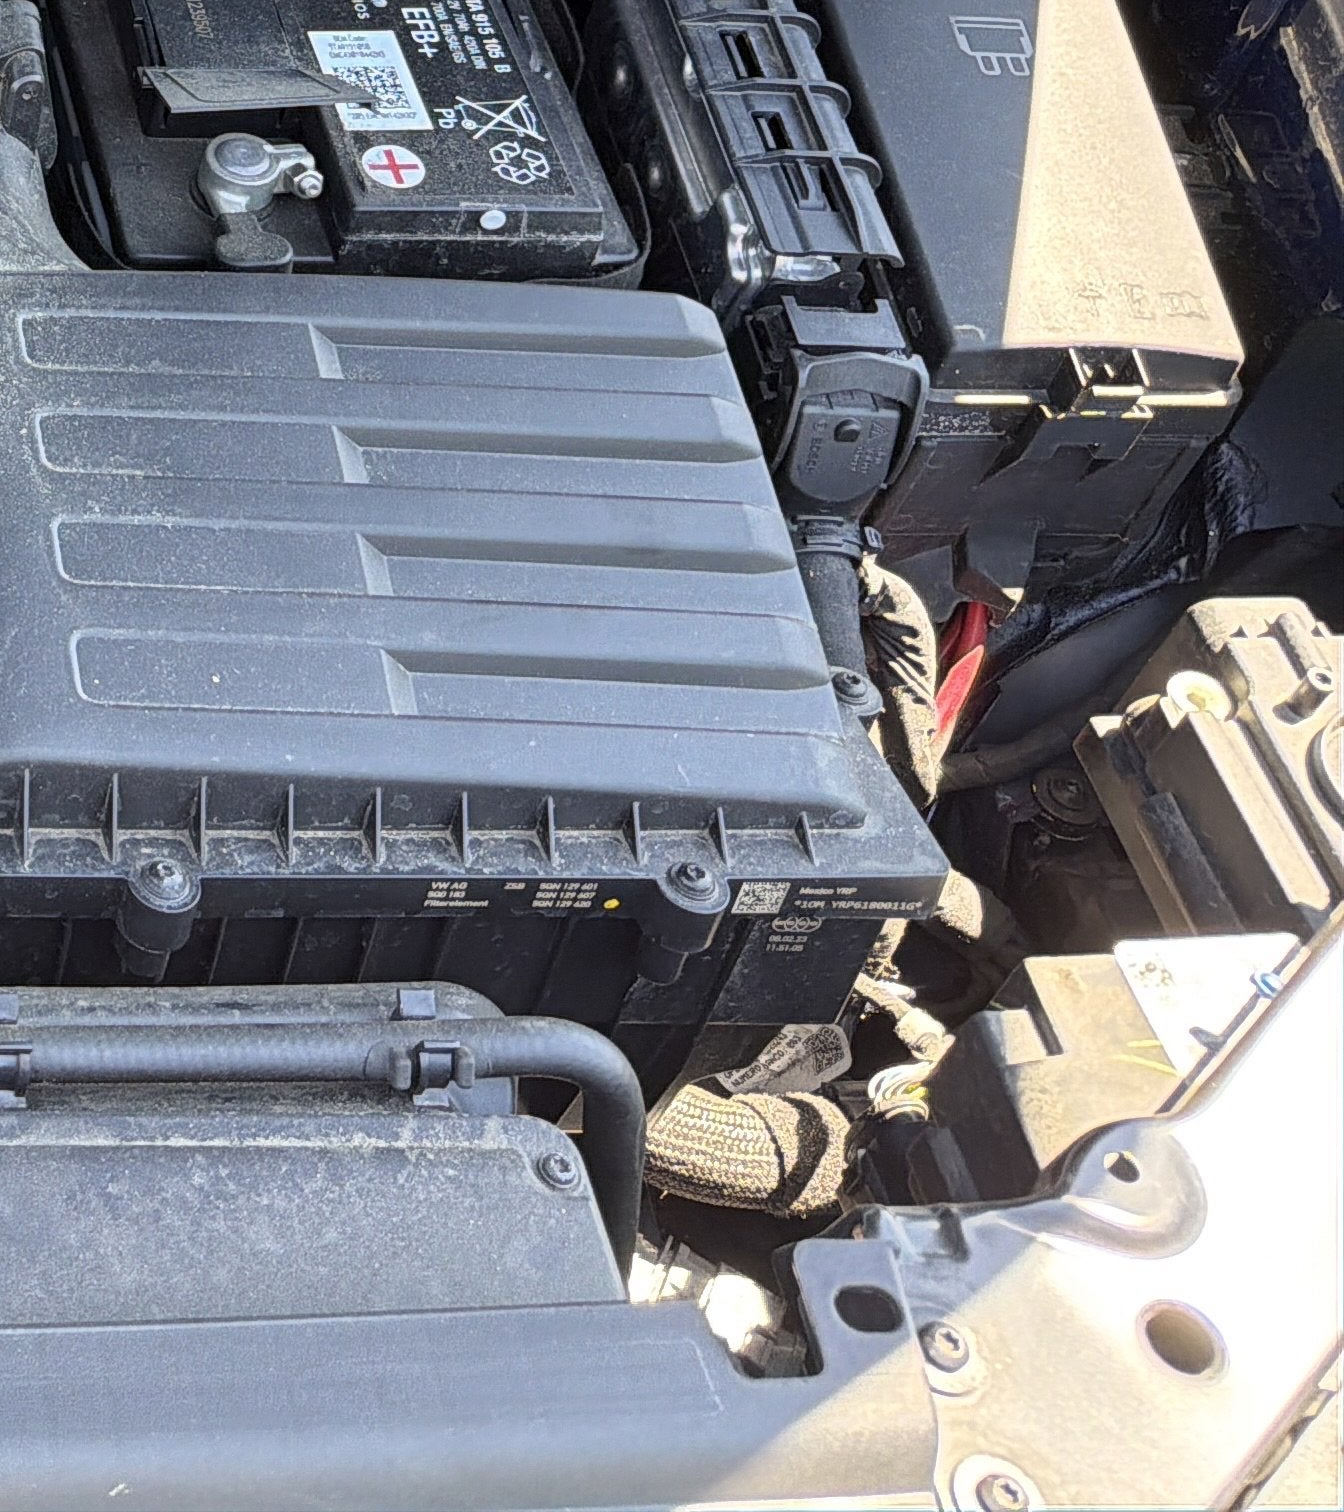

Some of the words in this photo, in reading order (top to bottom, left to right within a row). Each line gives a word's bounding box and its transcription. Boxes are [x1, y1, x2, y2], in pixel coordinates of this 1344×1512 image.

[401, 7, 440, 59] EFB+
[433, 108, 459, 129] Pb
[431, 881, 450, 890] VW
